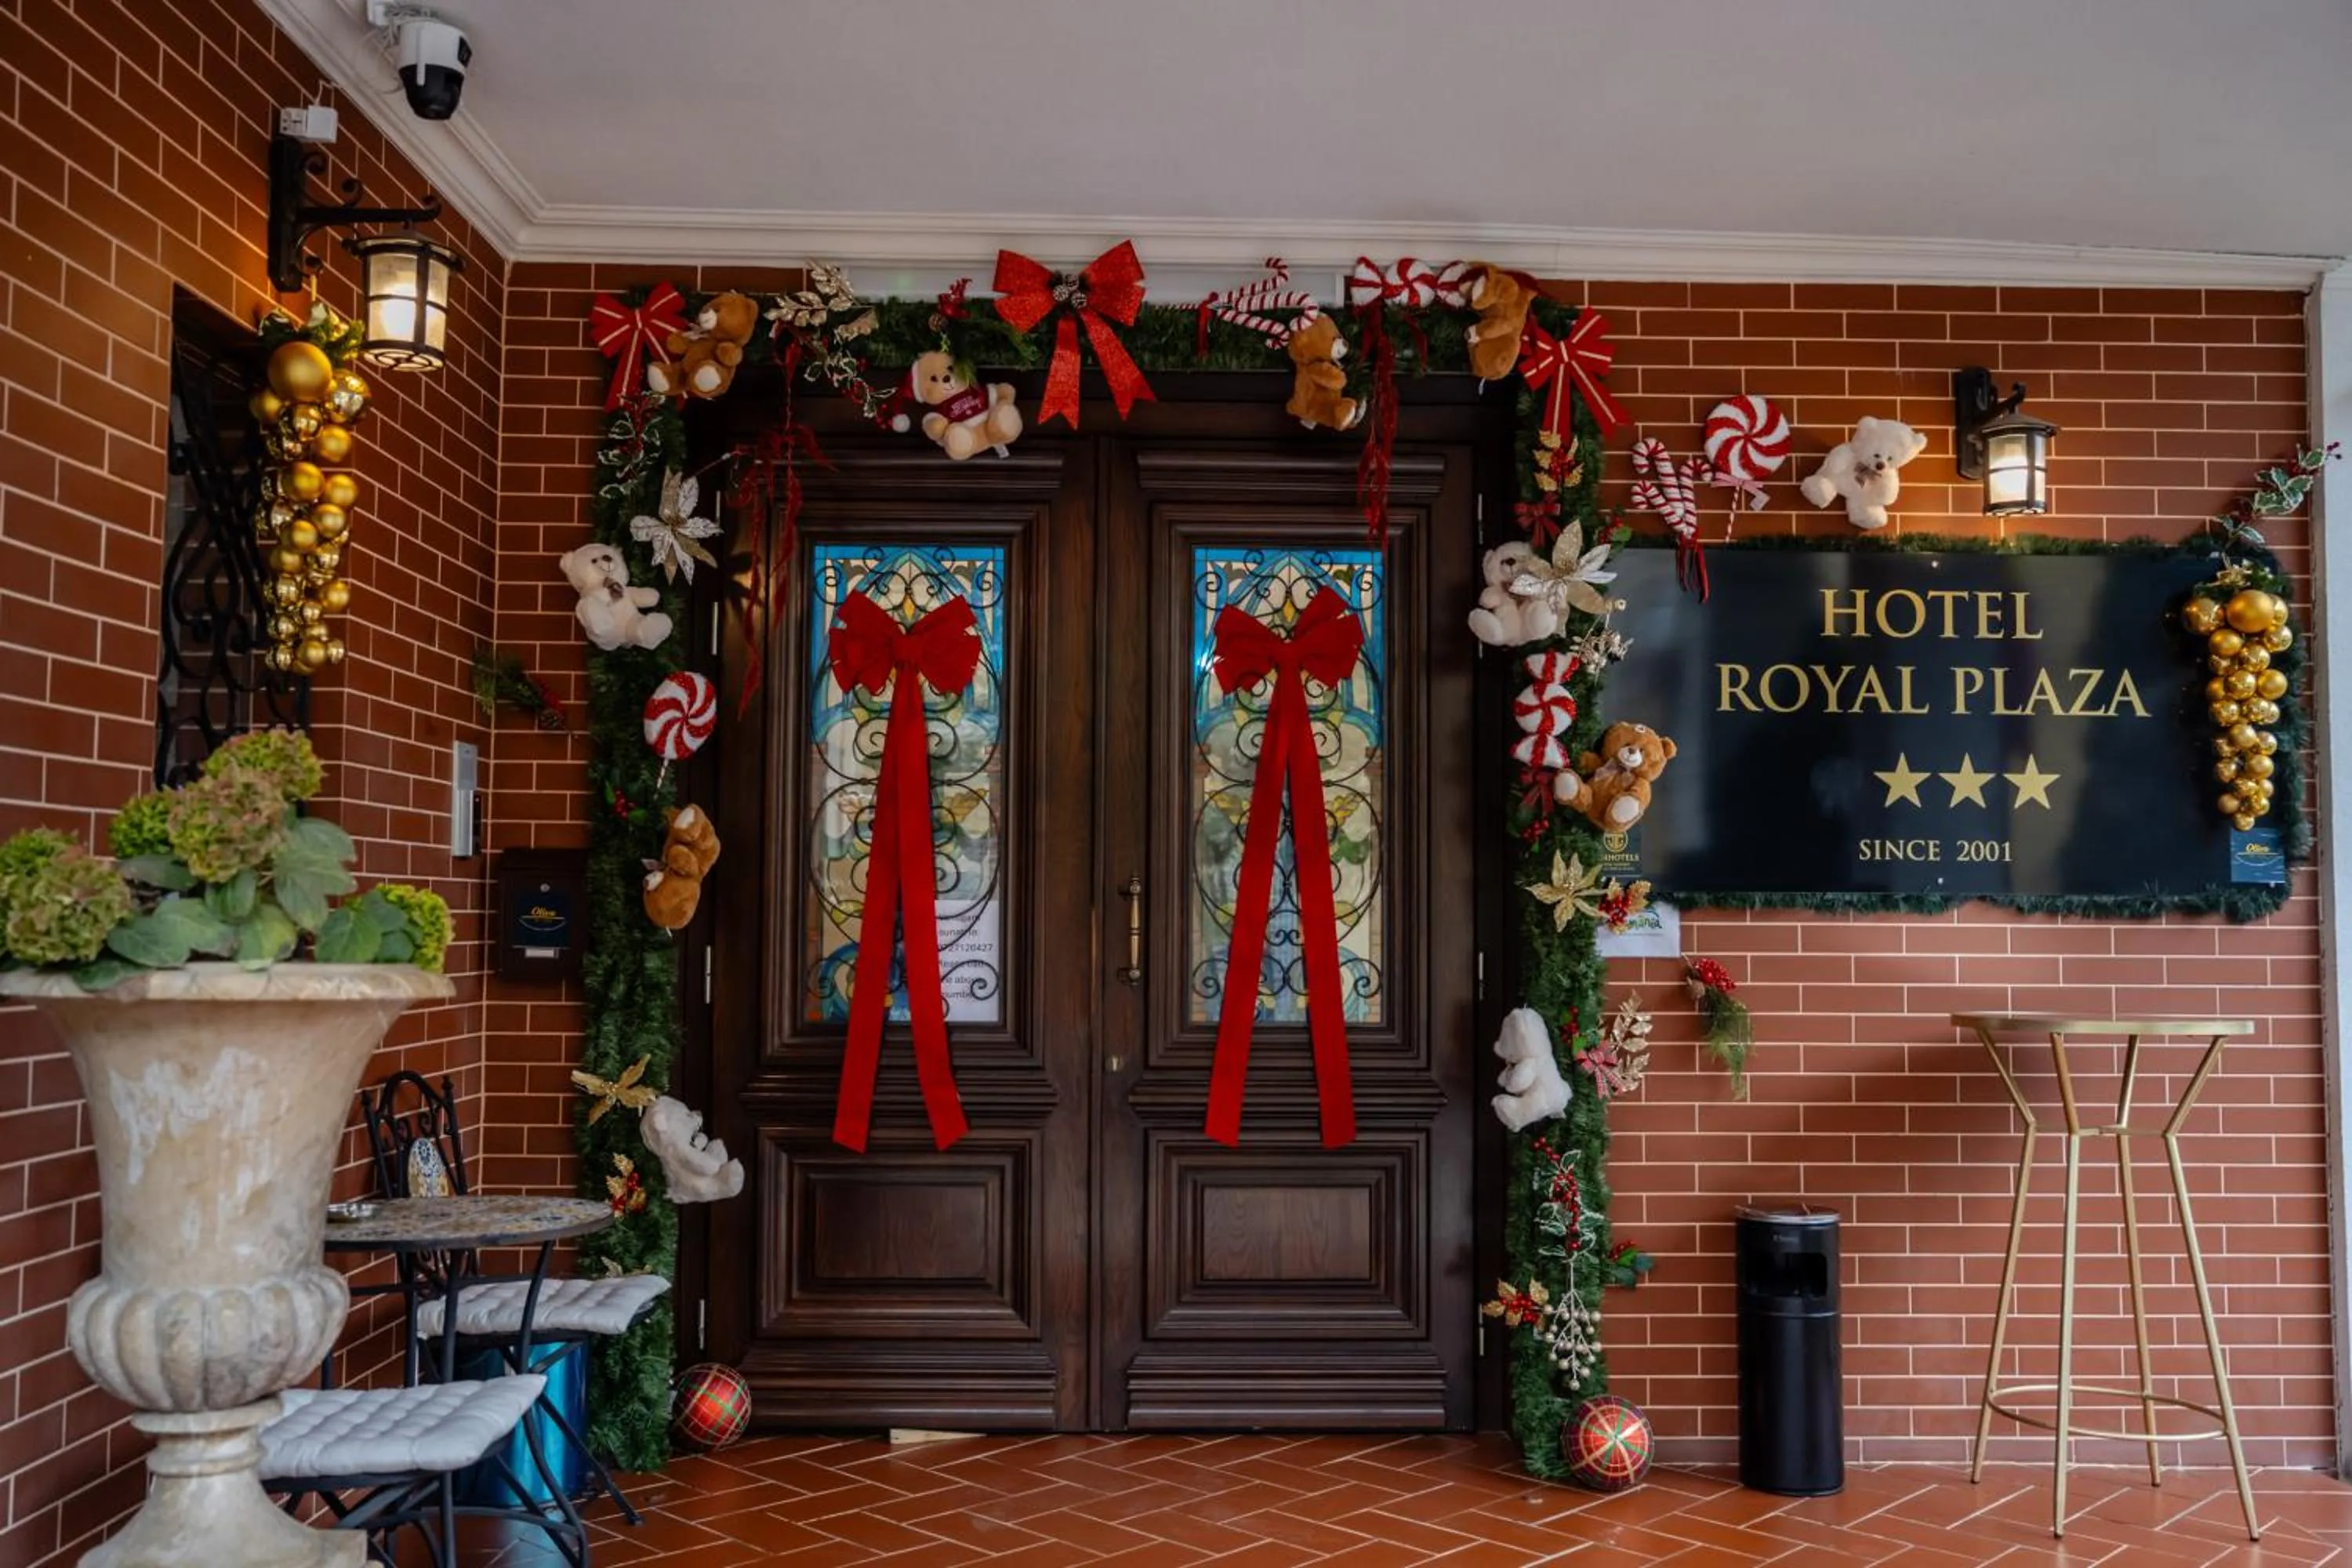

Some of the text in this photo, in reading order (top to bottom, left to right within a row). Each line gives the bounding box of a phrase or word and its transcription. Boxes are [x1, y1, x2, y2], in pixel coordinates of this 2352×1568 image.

[1820, 588, 2042, 640] HOTEL
[1715, 663, 2151, 717] ROYAL PLAZA
[1859, 840, 2013, 862] SINCE 2001
